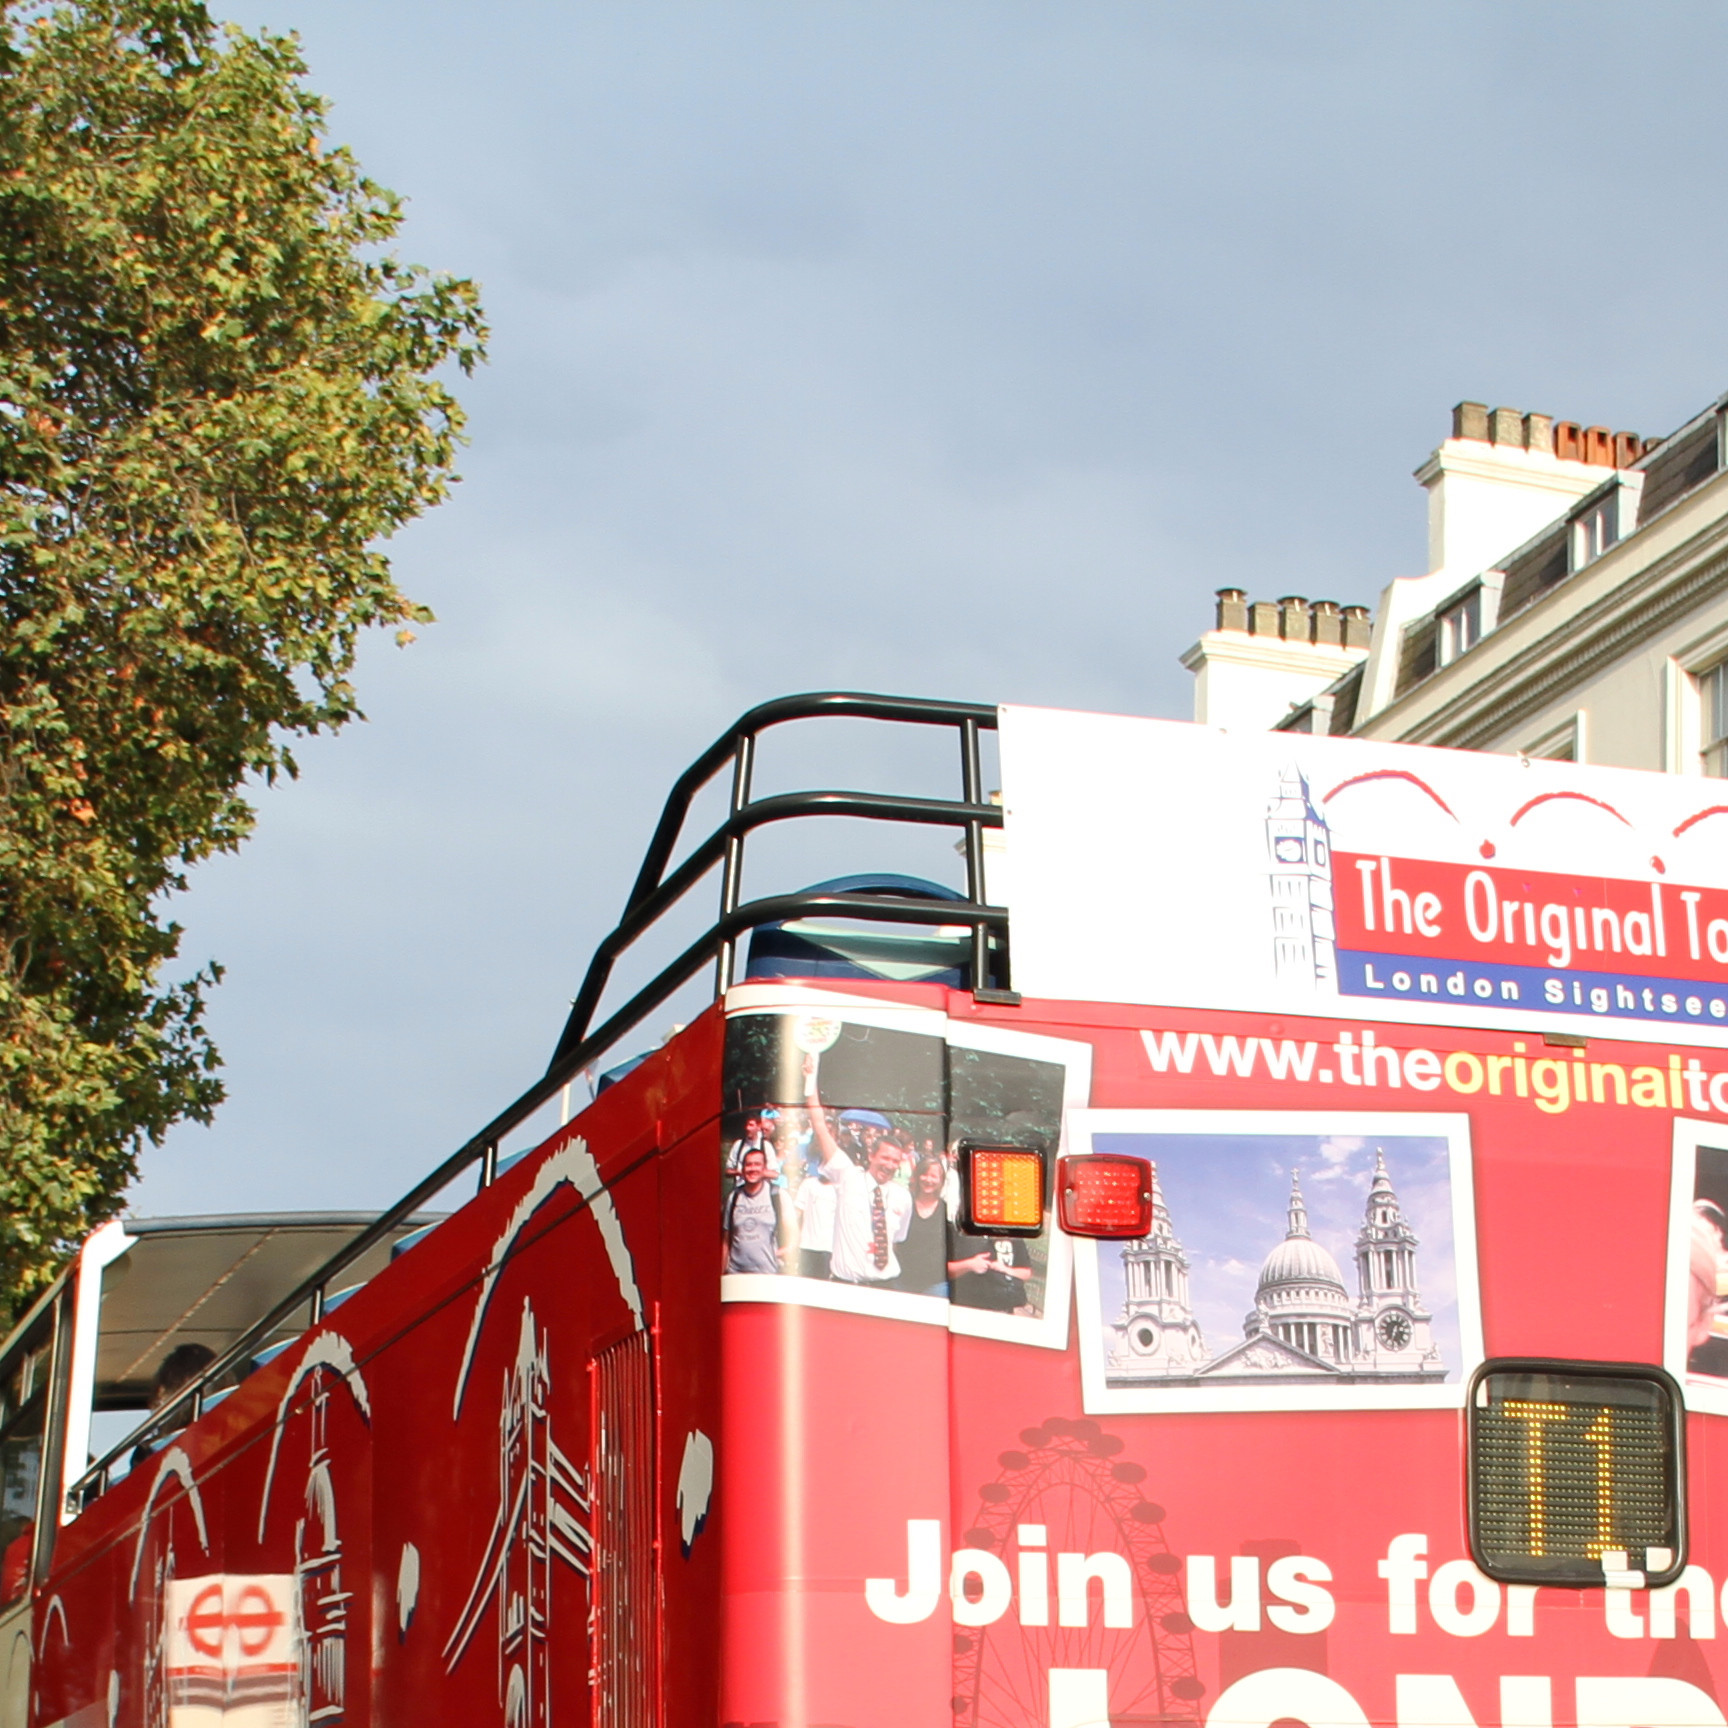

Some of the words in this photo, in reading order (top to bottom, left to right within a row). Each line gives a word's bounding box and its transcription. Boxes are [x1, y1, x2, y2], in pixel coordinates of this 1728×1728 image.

[1355, 857, 1443, 938] The
[1463, 869, 1668, 968] Original
[1365, 963, 1519, 1002] London
[1503, 1400, 1624, 1561] T1
[864, 1519, 1134, 1628] Join
[1186, 1552, 1337, 1634] us
[1377, 1534, 1540, 1638] for
